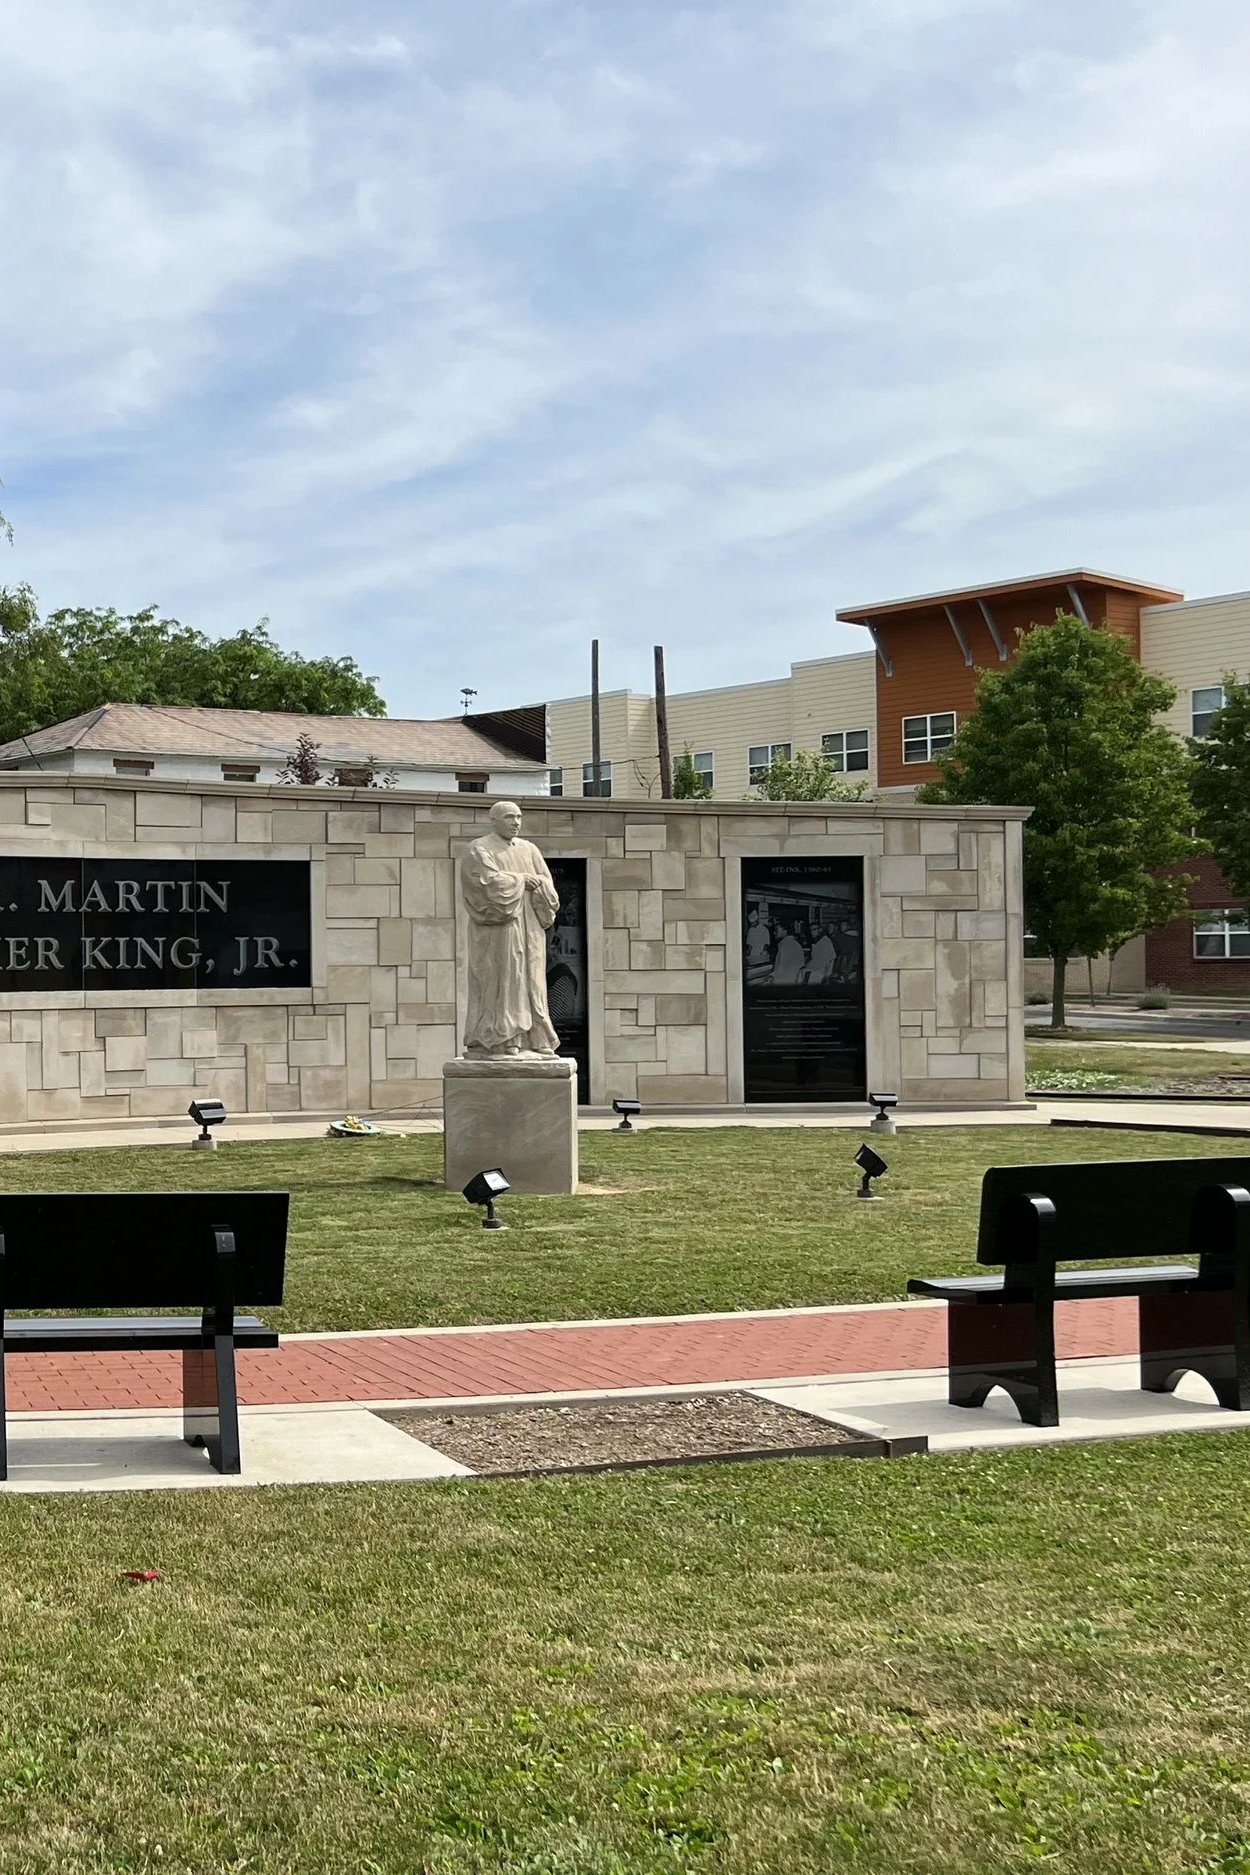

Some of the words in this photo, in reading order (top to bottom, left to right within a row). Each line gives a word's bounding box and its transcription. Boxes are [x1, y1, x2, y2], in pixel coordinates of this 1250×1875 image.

[37, 880, 231, 913] MARTIN
[83, 937, 215, 974] KING,
[233, 936, 299, 976] JR.
